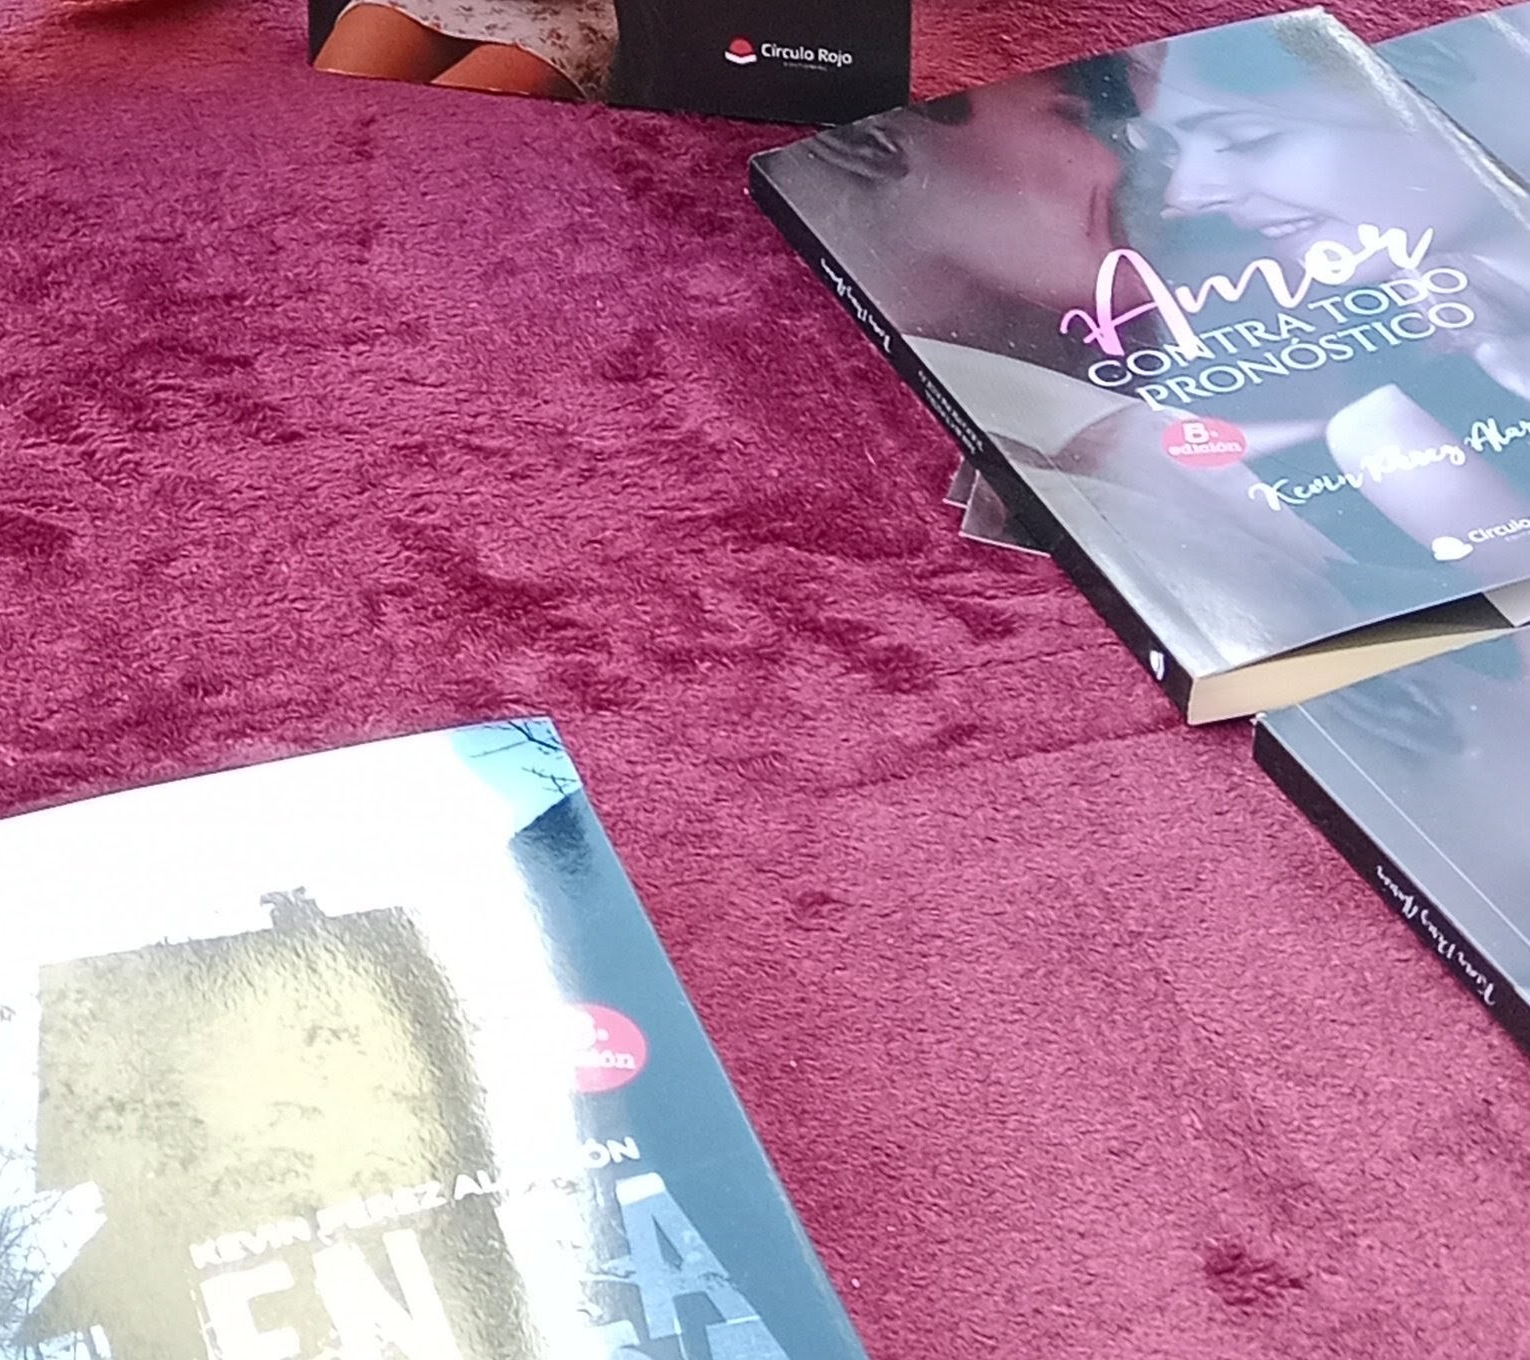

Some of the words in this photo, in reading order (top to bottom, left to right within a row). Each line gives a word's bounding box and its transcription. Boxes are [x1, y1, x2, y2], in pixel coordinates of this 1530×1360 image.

[817, 48, 852, 68] Rojo
[1059, 223, 1435, 357] Amor
[1087, 312, 1314, 388] CONTRA
[1307, 267, 1469, 326] TODO
[1134, 301, 1476, 412] PRONÓSTICO
[1463, 417, 1530, 452] Alar
